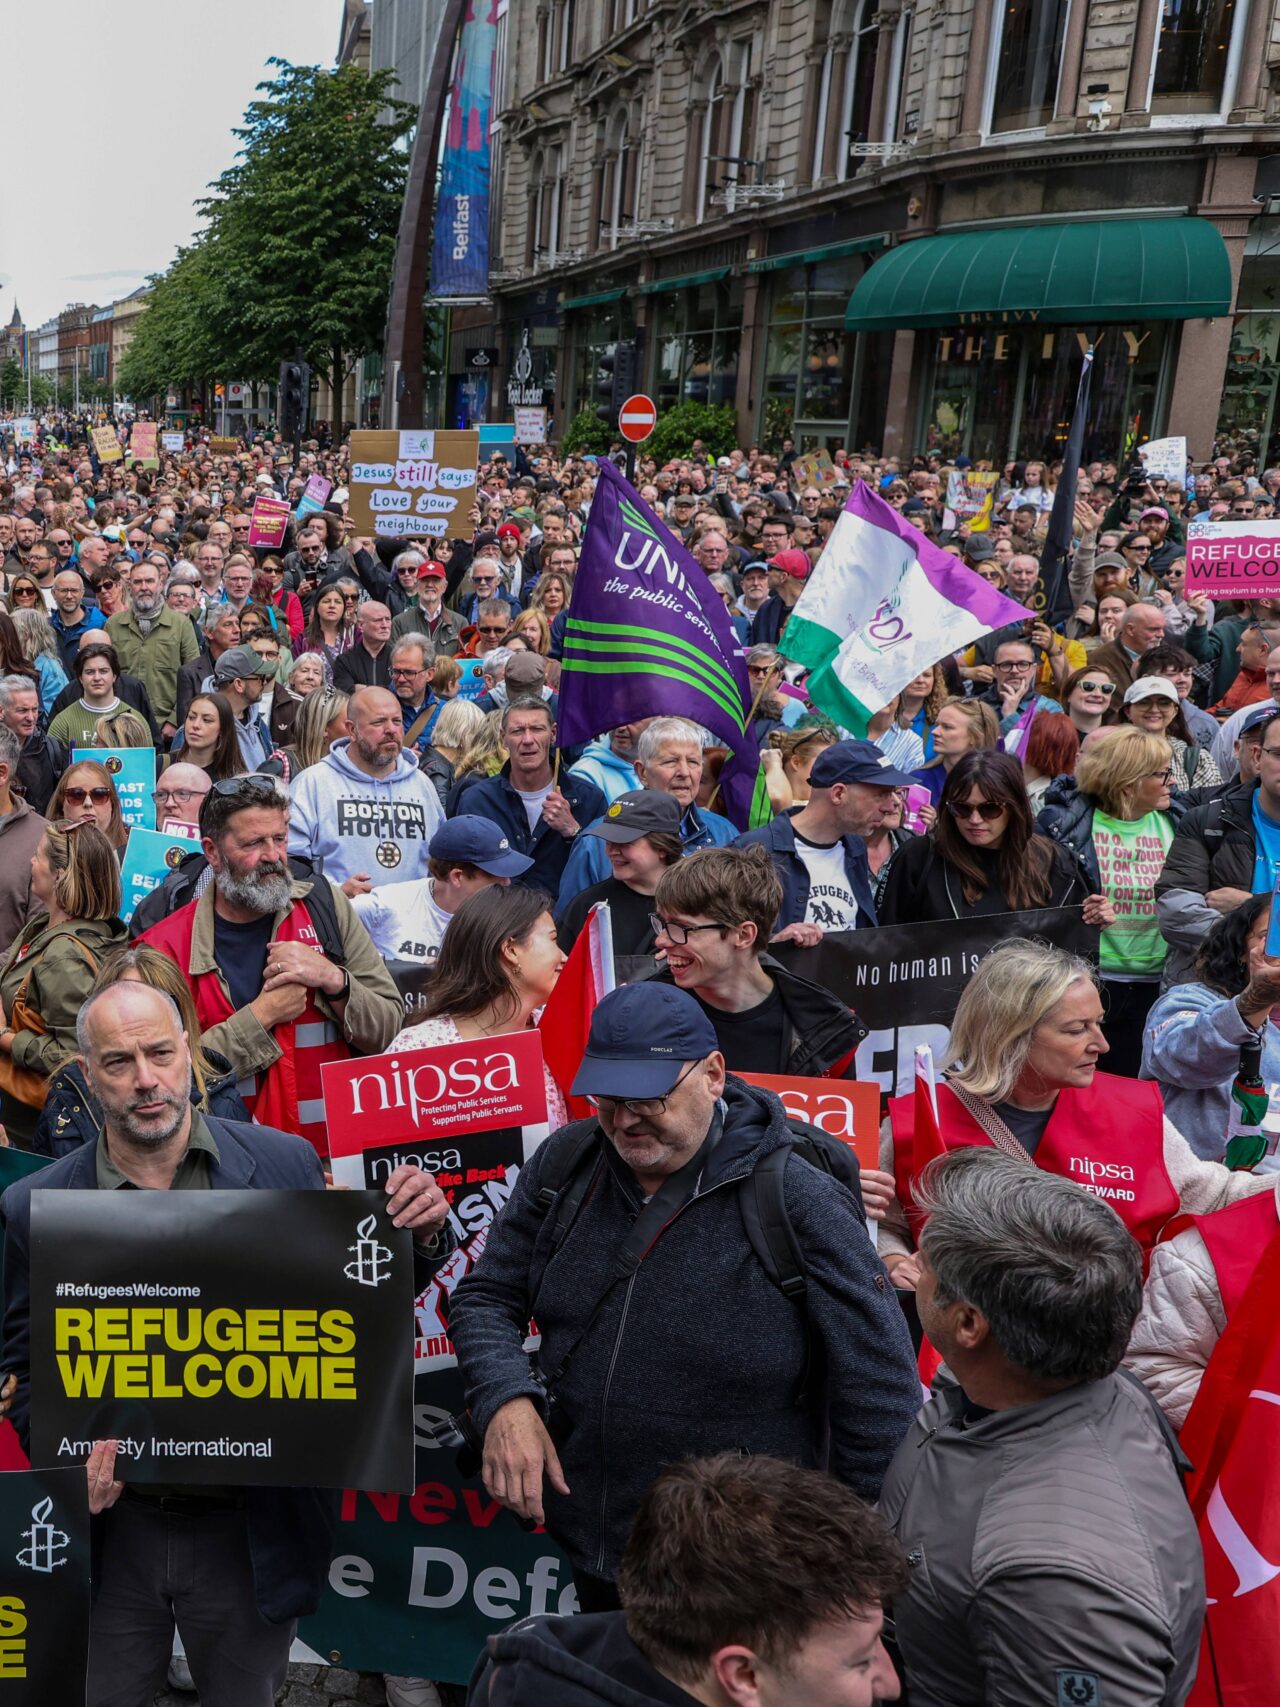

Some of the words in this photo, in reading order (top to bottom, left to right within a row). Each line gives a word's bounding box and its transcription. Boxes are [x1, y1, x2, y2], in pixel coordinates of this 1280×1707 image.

[453, 193, 470, 259] Belfast
[959, 312, 993, 323] THE
[1003, 310, 1040, 322] IVY
[939, 334, 1009, 361] THE
[1042, 331, 1151, 363] IVY
[507, 383, 520, 404] Foot
[522, 383, 543, 404] Locker
[354, 466, 392, 478] Jesus
[400, 466, 433, 482] still
[440, 471, 472, 486] says:
[373, 493, 408, 507] Love
[420, 499, 452, 511] your
[378, 518, 444, 533] neighbour
[603, 577, 627, 594] the
[629, 585, 683, 613] public
[1220, 587, 1248, 595] asylum
[343, 803, 423, 822] BOSTON
[338, 820, 426, 840] HOCKEY
[1113, 847, 1132, 859] ON
[1113, 861, 1131, 873] ON
[1114, 875, 1133, 886] ON
[808, 884, 854, 907] EFUGEES
[1114, 887, 1134, 900] ON
[1113, 901, 1132, 914] ON
[856, 964, 880, 986] No
[889, 955, 951, 983] human
[962, 952, 979, 974] is
[349, 1052, 520, 1128] nipsa
[421, 1102, 457, 1116] Protecting
[457, 1099, 479, 1110] Public
[479, 1095, 507, 1106] Services
[432, 1113, 471, 1126] Supporting
[471, 1109, 492, 1120] Public
[493, 1104, 523, 1116] Servants
[466, 1164, 507, 1181] Back
[1069, 1156, 1134, 1183] nipsa
[56, 1283, 201, 1299] #RefugeesWelcome
[55, 1308, 357, 1354] REFUGEES
[57, 1353, 357, 1400] WELCOME
[57, 1436, 145, 1460] Amsty
[151, 1437, 272, 1458] International
